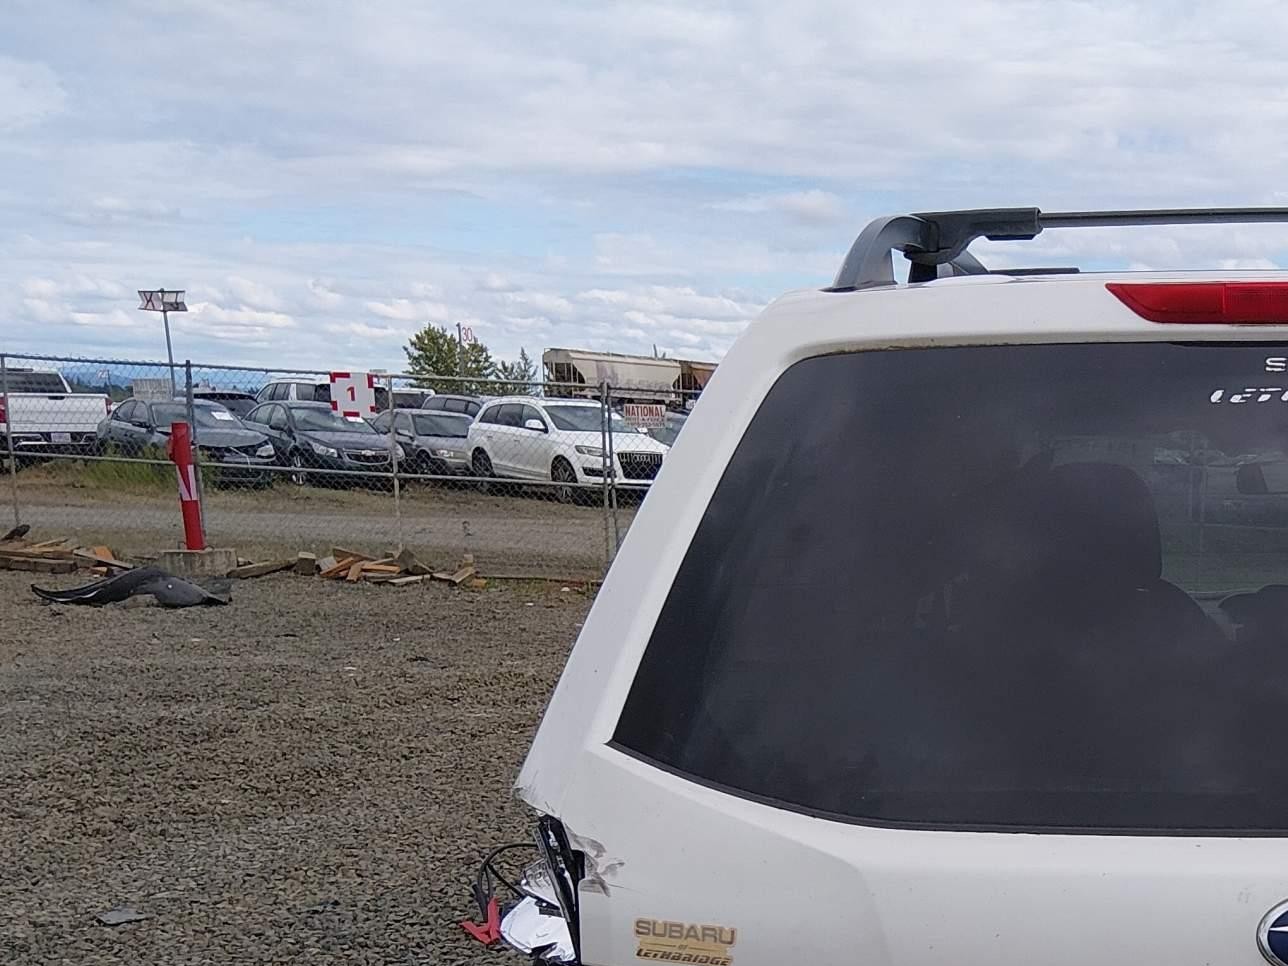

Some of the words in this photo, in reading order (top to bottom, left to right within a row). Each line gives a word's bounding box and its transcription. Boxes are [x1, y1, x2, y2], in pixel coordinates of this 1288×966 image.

[347, 386, 355, 401] 1
[625, 406, 664, 416] NATIONAL
[635, 919, 736, 945] SUBARU
[636, 948, 732, 966] LETHBRIDGE
